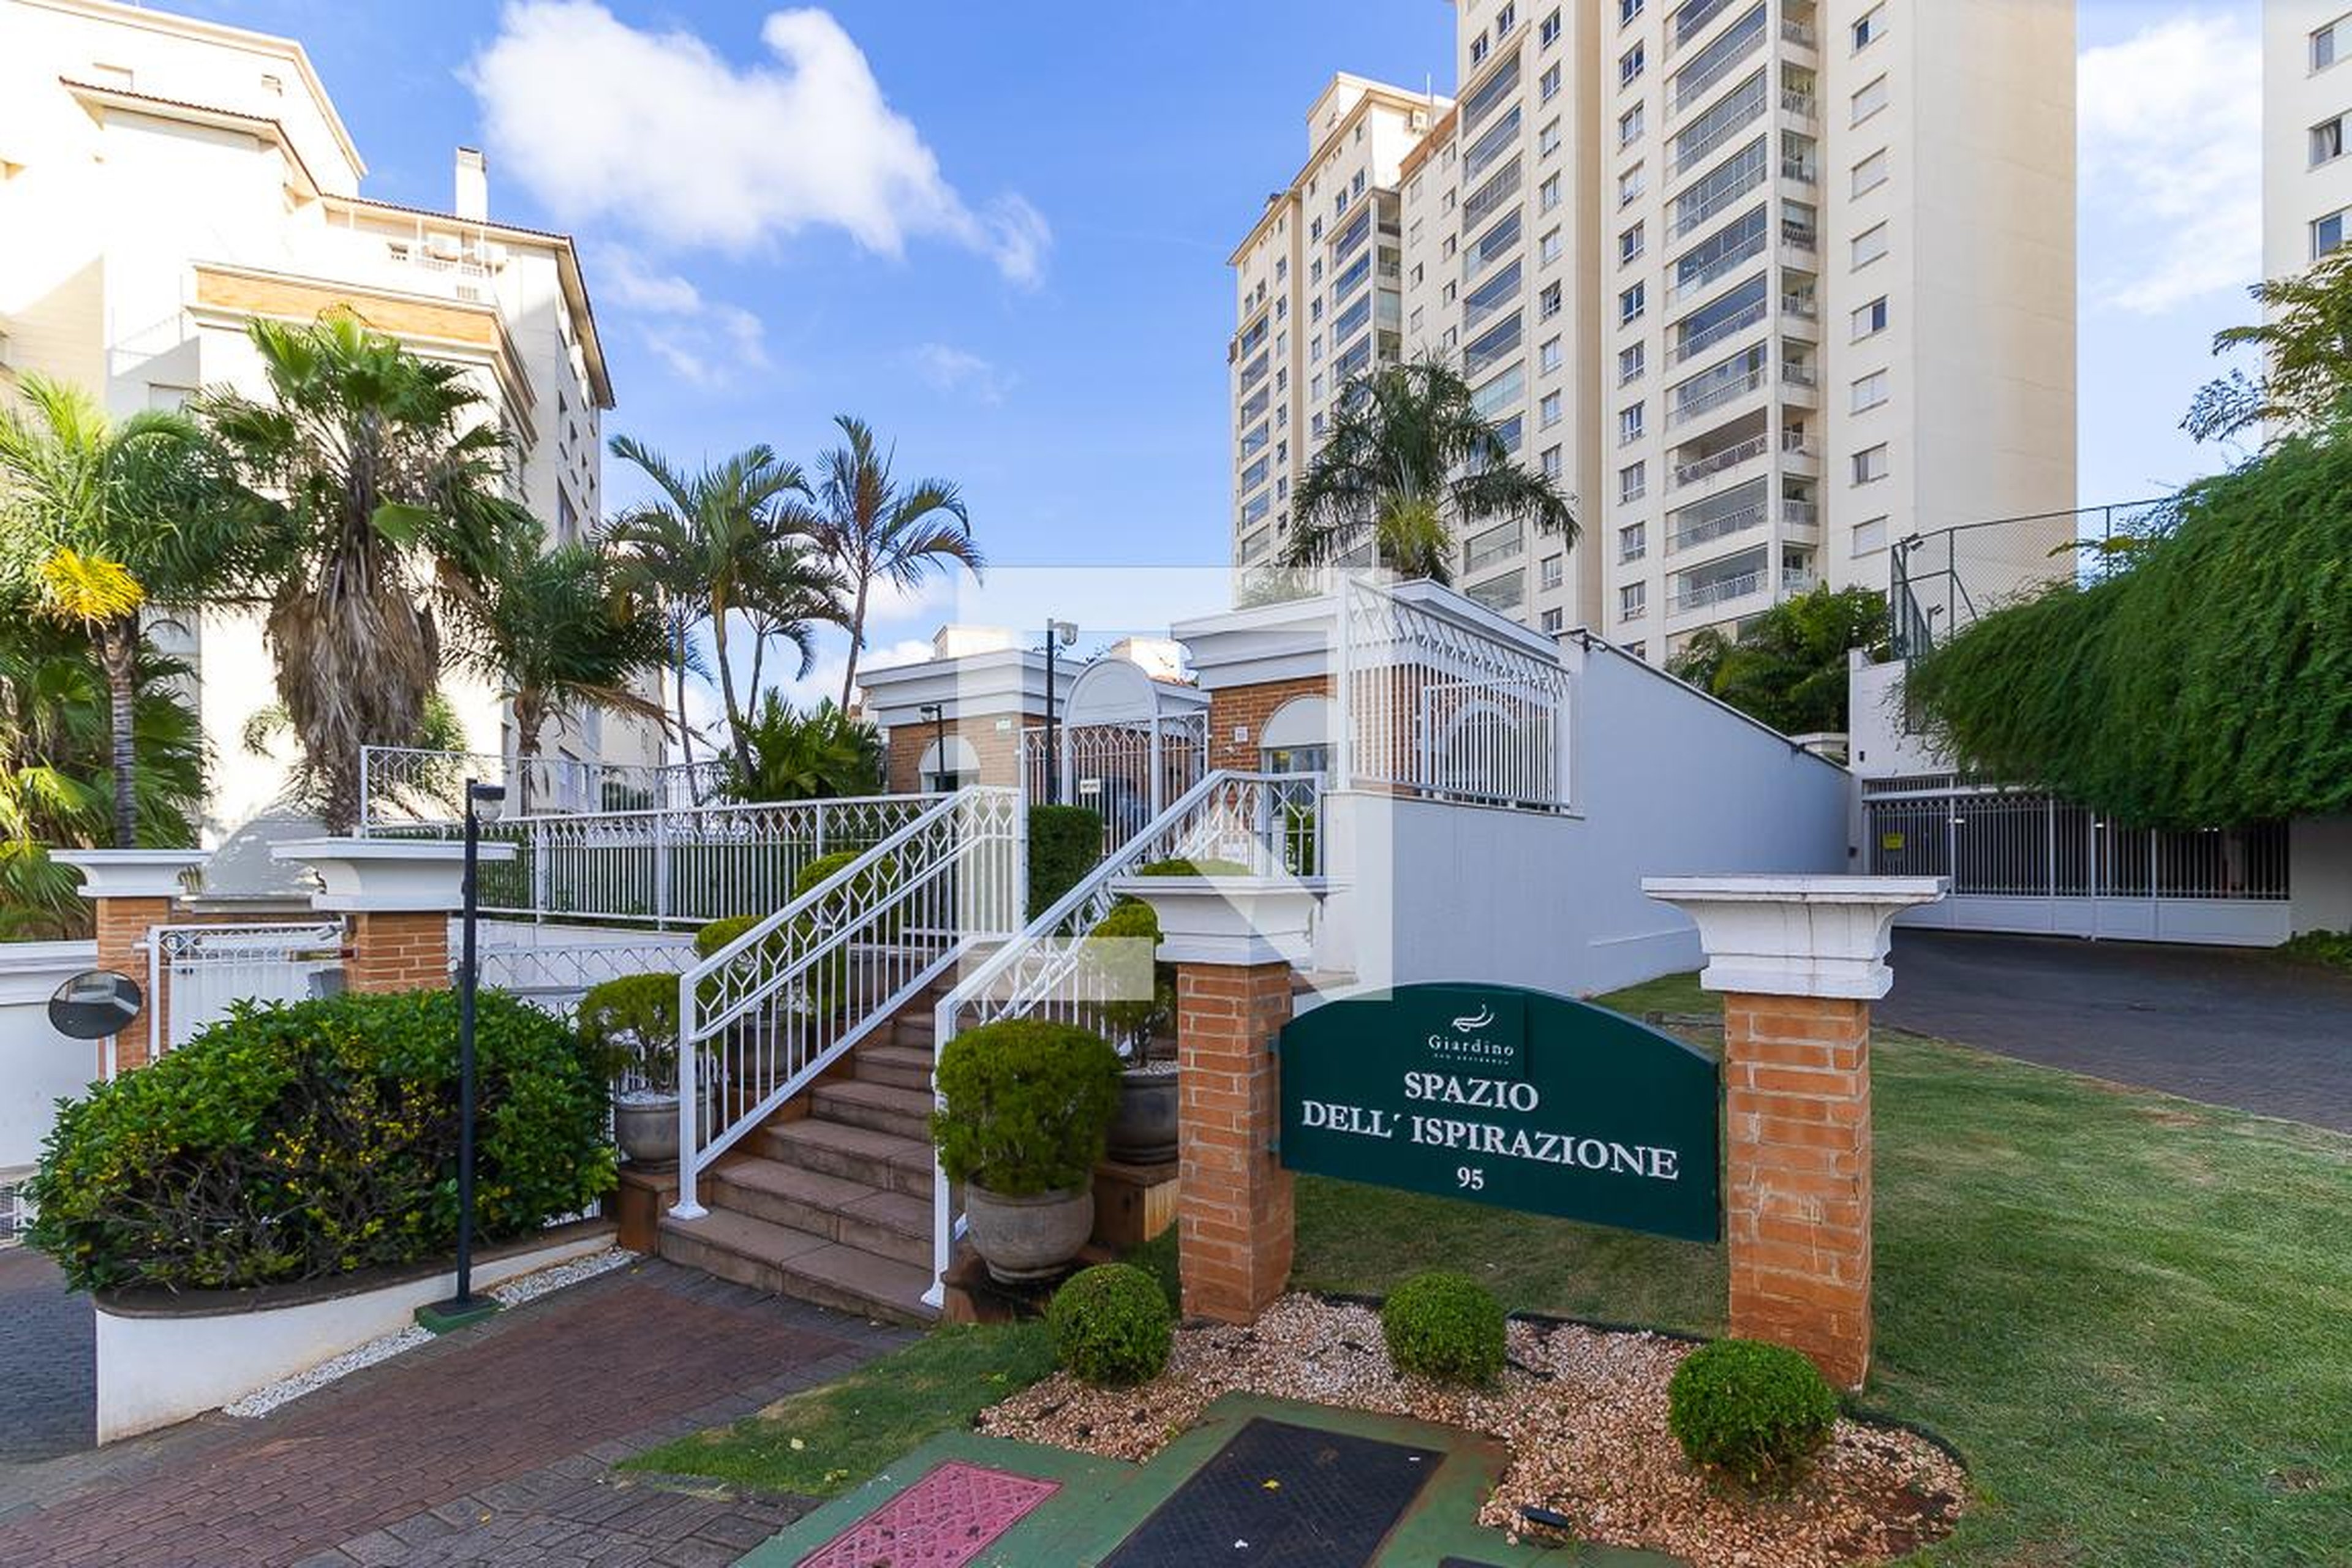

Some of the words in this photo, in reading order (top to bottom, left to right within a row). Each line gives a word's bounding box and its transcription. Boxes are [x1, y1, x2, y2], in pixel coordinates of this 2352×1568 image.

[1428, 1035, 1514, 1056] Giardino
[1404, 1071, 1538, 1112] SPAZIO
[1411, 1115, 1679, 1180] ISPIRAZIONE
[1457, 1167, 1484, 1190] 95
